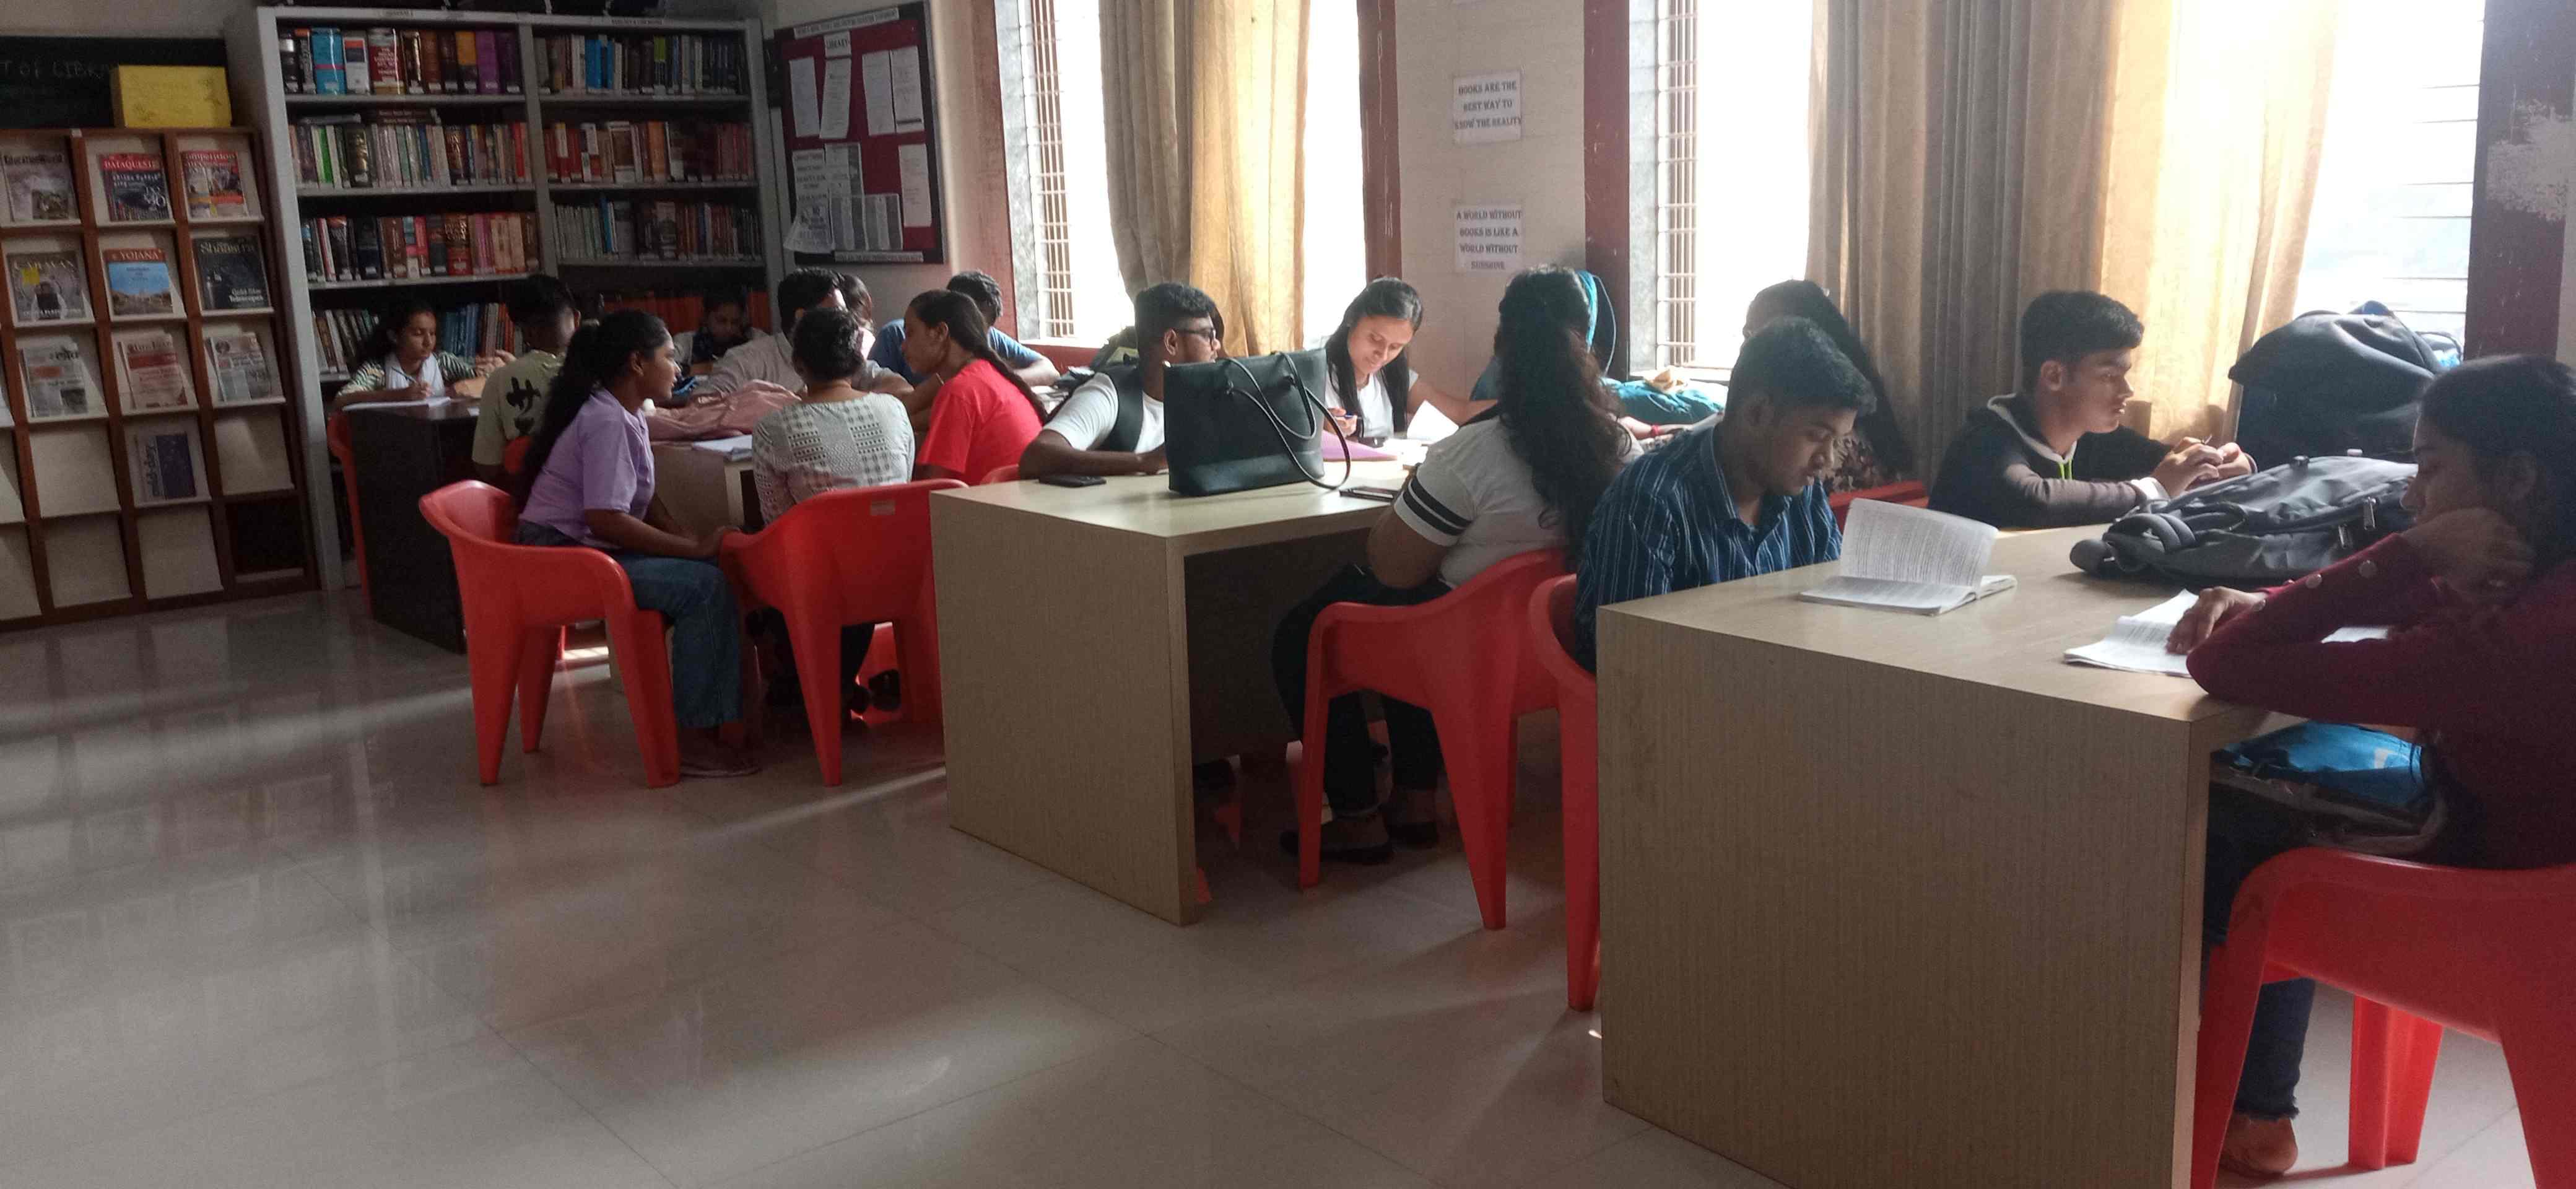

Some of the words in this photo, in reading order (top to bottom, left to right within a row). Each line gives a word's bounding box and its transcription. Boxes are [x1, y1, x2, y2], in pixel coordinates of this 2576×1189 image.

[1458, 84, 1482, 94] BOOKS
[1485, 82, 1500, 93] ARE
[1501, 81, 1516, 91] THE
[1463, 102, 1482, 111] BEST
[1483, 99, 1500, 110] WAY
[1502, 99, 1513, 108] TO
[1455, 118, 1474, 129] KNOW
[1476, 118, 1490, 128] THE
[1492, 115, 1522, 127] REALITY
[1456, 211, 1461, 220] A
[1463, 210, 1487, 219] WORLD
[1489, 209, 1521, 220] WITHOUT
[1460, 228, 1483, 237] BOOKS
[1485, 228, 1491, 237] IS
[1494, 227, 1510, 237] LIKE
[1512, 227, 1518, 237] A
[1460, 243, 1484, 253] WORLD
[1486, 243, 1518, 253] WITHOUT
